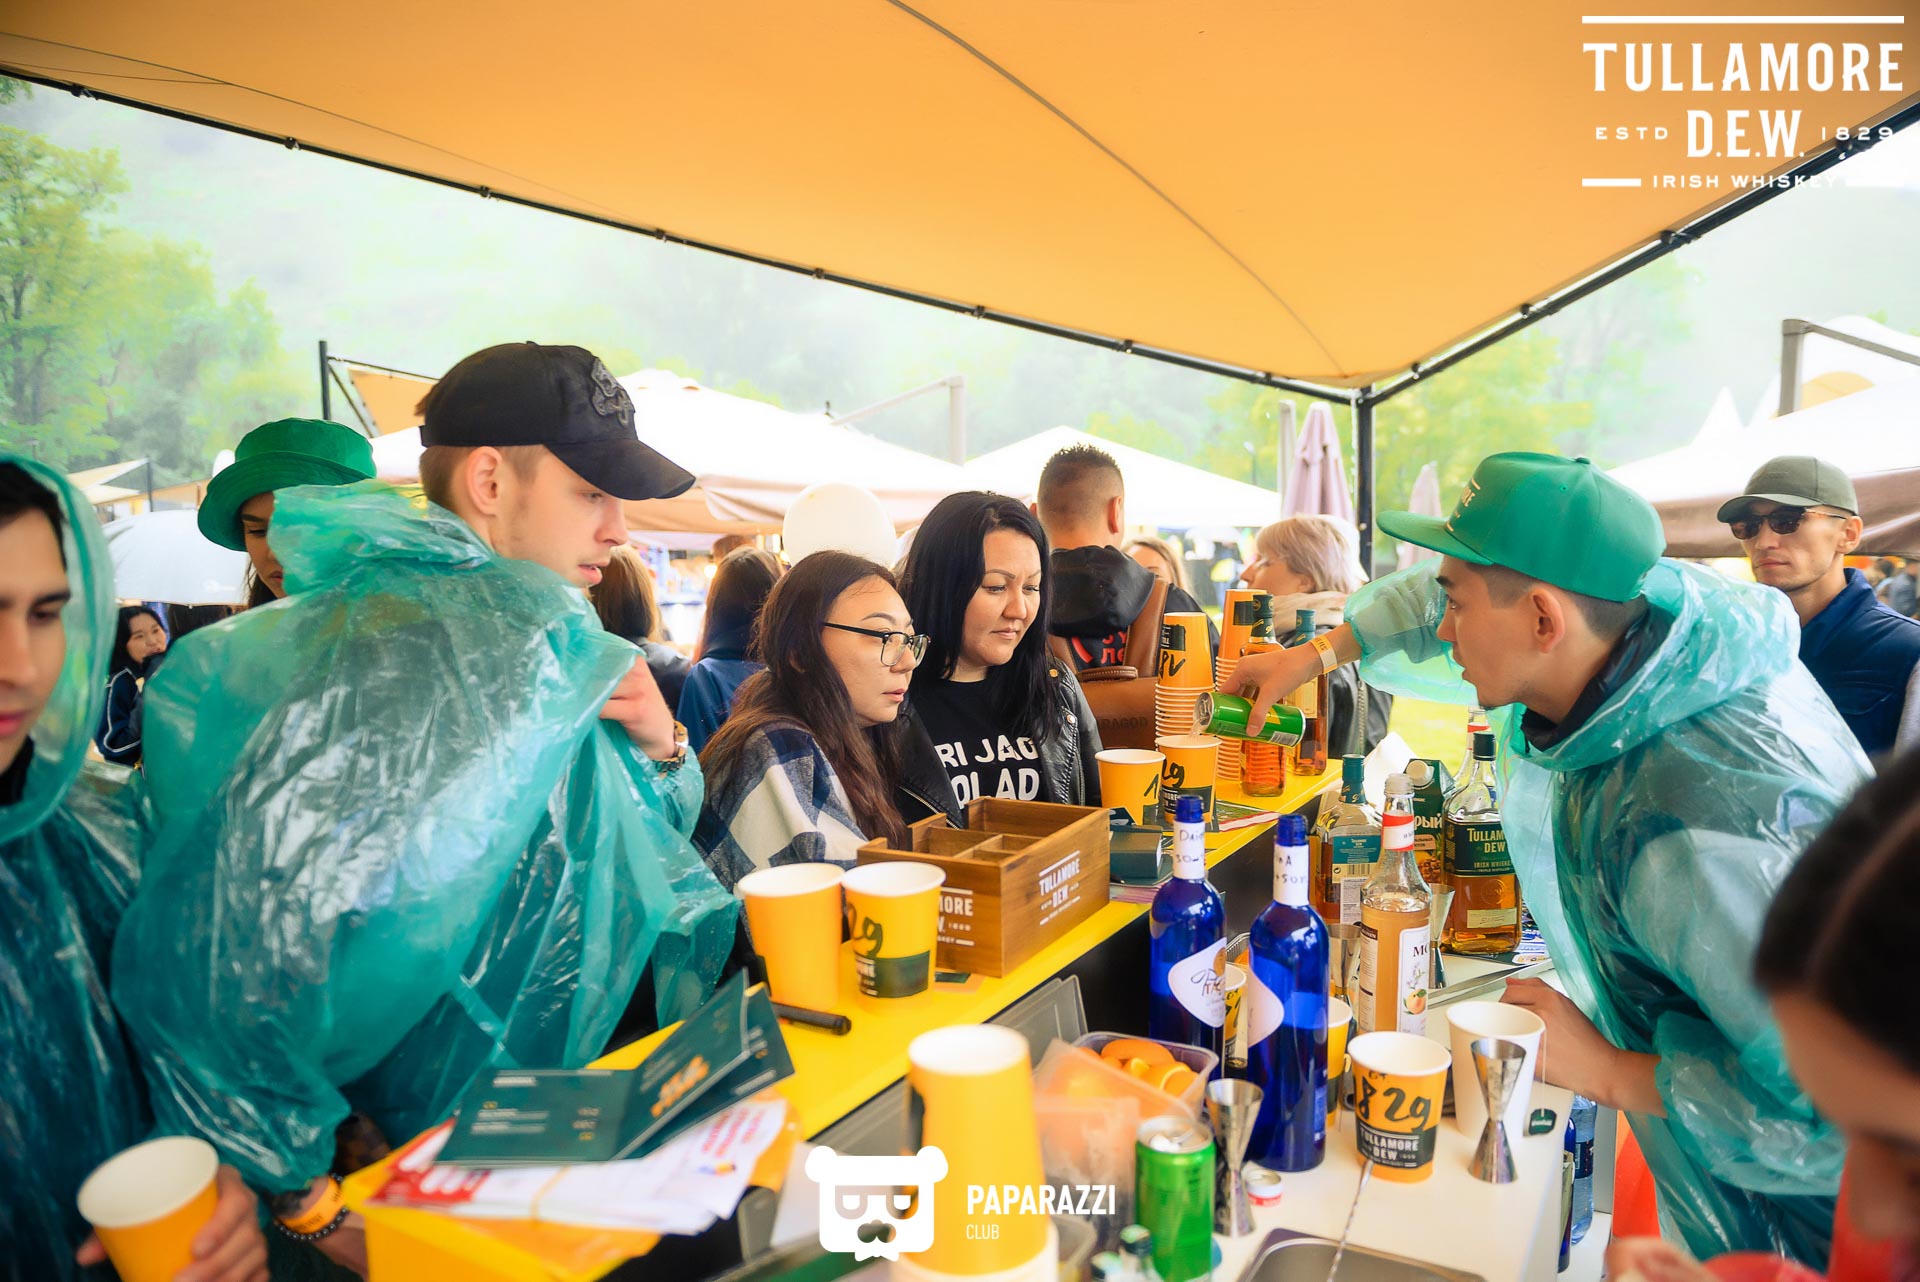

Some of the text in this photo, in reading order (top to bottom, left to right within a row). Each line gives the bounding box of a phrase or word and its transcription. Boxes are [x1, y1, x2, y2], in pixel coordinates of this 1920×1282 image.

[1484, 841, 1505, 853] DEW
[1039, 858, 1080, 897] TULLAMORE
[1361, 1128, 1419, 1151] TULLAMORE
